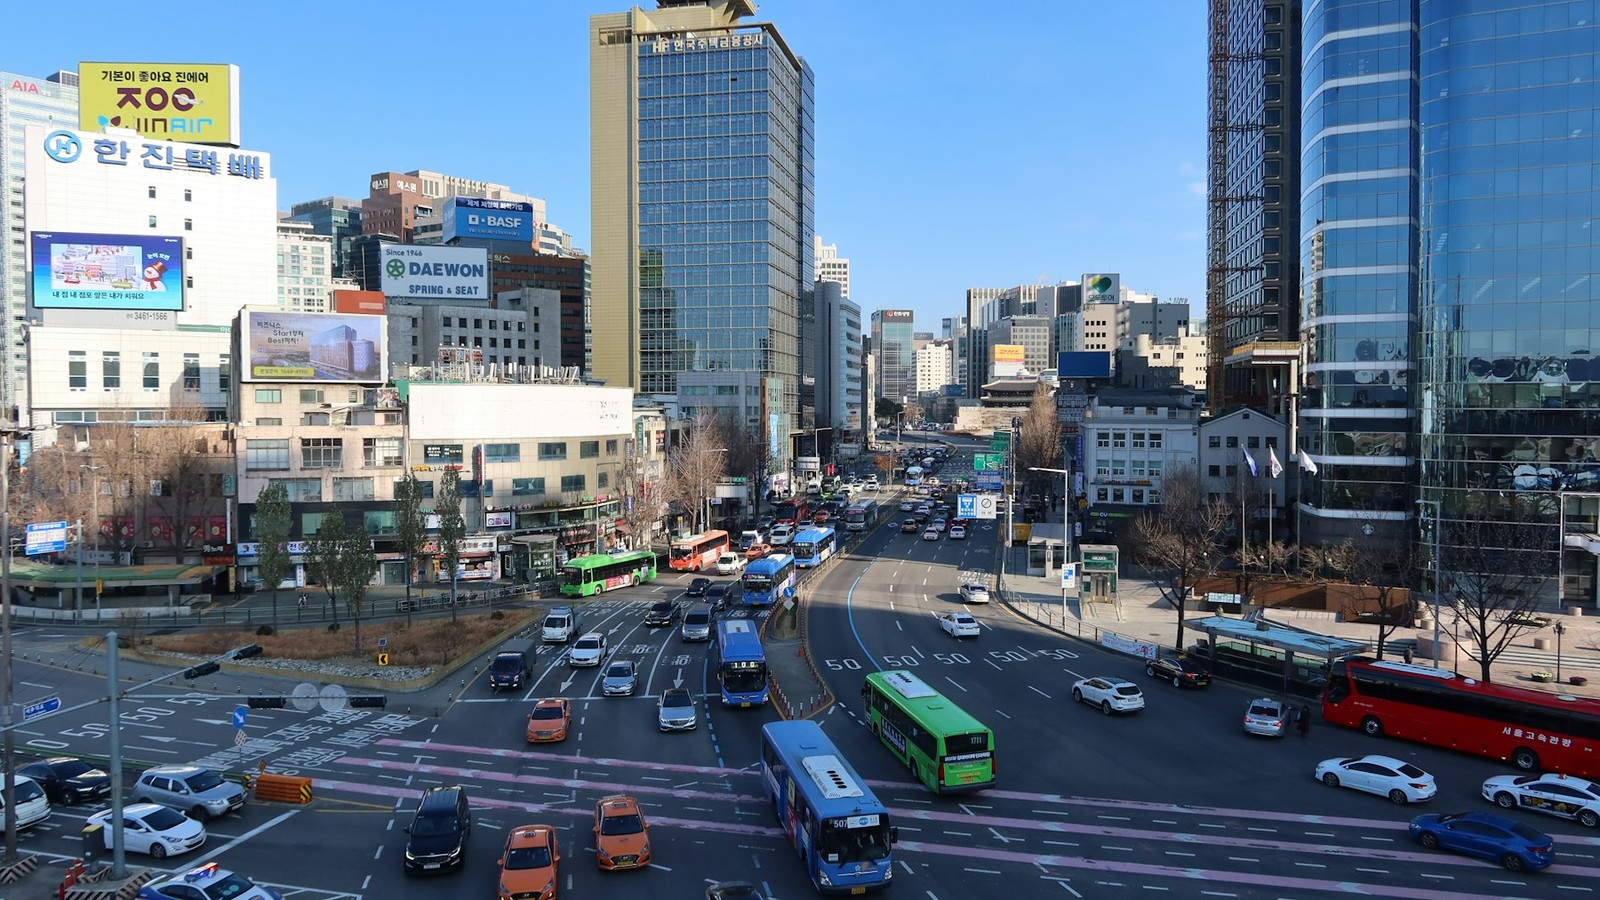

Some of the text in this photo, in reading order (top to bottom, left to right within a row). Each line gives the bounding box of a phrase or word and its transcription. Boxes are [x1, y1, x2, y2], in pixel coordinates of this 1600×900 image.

[652, 38, 670, 53] HF
[673, 33, 763, 51] 한국주택금융공사
[101, 70, 209, 83] 기본이 좋아요 진에어
[12, 79, 39, 94] AIA
[93, 138, 264, 180] 한진택배
[371, 178, 389, 190] 에스원
[396, 180, 417, 193] 에스원
[486, 215, 522, 228] BASF
[386, 248, 423, 257] Since 1946
[409, 262, 484, 278] DAEWON
[52, 291, 60, 299] 내
[70, 291, 77, 299] 내
[109, 292, 123, 300] 내가
[409, 284, 479, 296] SPRING & SEAT
[134, 312, 168, 320] 3461-1566
[933, 653, 971, 665] 50
[989, 650, 1028, 663] 50
[1038, 648, 1080, 661] 50
[733, 661, 755, 669] 100
[825, 658, 862, 670] 50
[883, 655, 920, 667] 50
[970, 737, 982, 745] 1711
[1502, 726, 1572, 748] 서울고속관광
[833, 819, 848, 828] 507
